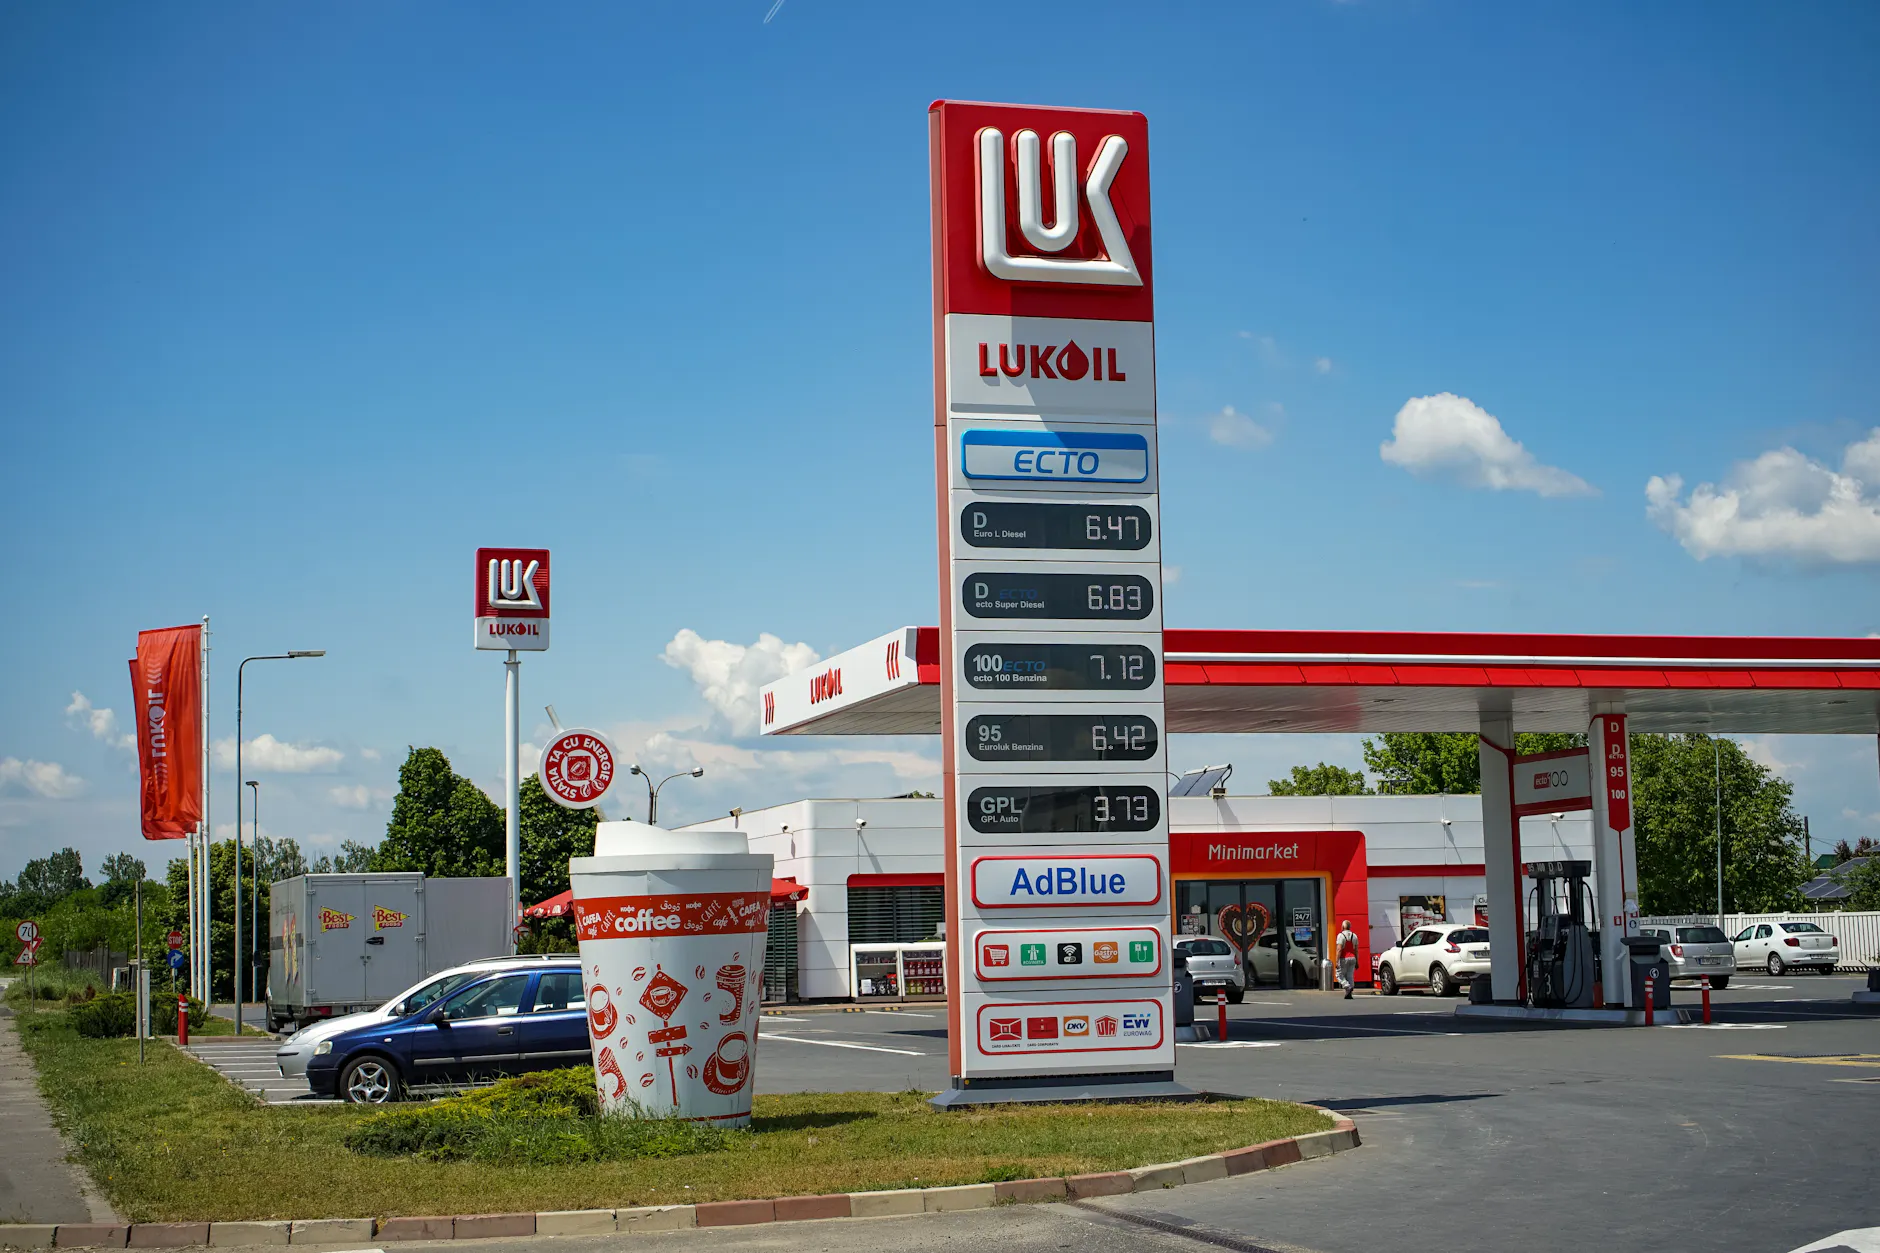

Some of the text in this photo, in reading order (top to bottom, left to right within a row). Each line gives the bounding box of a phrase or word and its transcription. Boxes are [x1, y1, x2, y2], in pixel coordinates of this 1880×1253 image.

[974, 127, 1143, 286] LUK
[978, 340, 1126, 382] LUKOIL
[1014, 450, 1100, 475] ECTO
[973, 512, 988, 529] D
[1086, 515, 1140, 541] 6.47
[974, 530, 993, 538] Euro
[1002, 530, 1026, 538] Diesel
[489, 558, 544, 610] LUK
[975, 582, 1038, 600] D ECTO
[995, 601, 1019, 610] Super
[1020, 601, 1045, 609] Diesel
[1088, 585, 1142, 611] 6.83
[489, 622, 540, 636] LUKOIL
[972, 654, 1003, 672] 100
[1090, 655, 1144, 680] 7.12
[811, 667, 843, 705] LUKOIL
[995, 674, 1011, 682] 100
[1012, 674, 1048, 682] Benzina
[978, 725, 1002, 742] 95
[1611, 722, 1619, 733] D
[1092, 725, 1146, 751] 6.42
[978, 743, 1044, 751] Euroluk Benzina
[1612, 744, 1620, 755] D
[563, 737, 579, 749] CU
[583, 738, 611, 781] ENERGIE
[1610, 766, 1624, 777] 95
[1611, 789, 1626, 800] 100
[980, 797, 1022, 814] GPL
[1094, 796, 1148, 821] 3.73
[999, 815, 1019, 823] Auto
[1208, 842, 1299, 861] Minimarket
[1010, 867, 1126, 896] AdBlue
[322, 911, 349, 924] Best
[376, 909, 402, 922] Best
[614, 908, 681, 932] coffee
[1294, 913, 1310, 921] 24/7
[168, 936, 183, 945] STOP
[1094, 949, 1118, 957] Gastro
[1067, 1022, 1086, 1030] DKV
[1096, 1016, 1117, 1036] UTA
